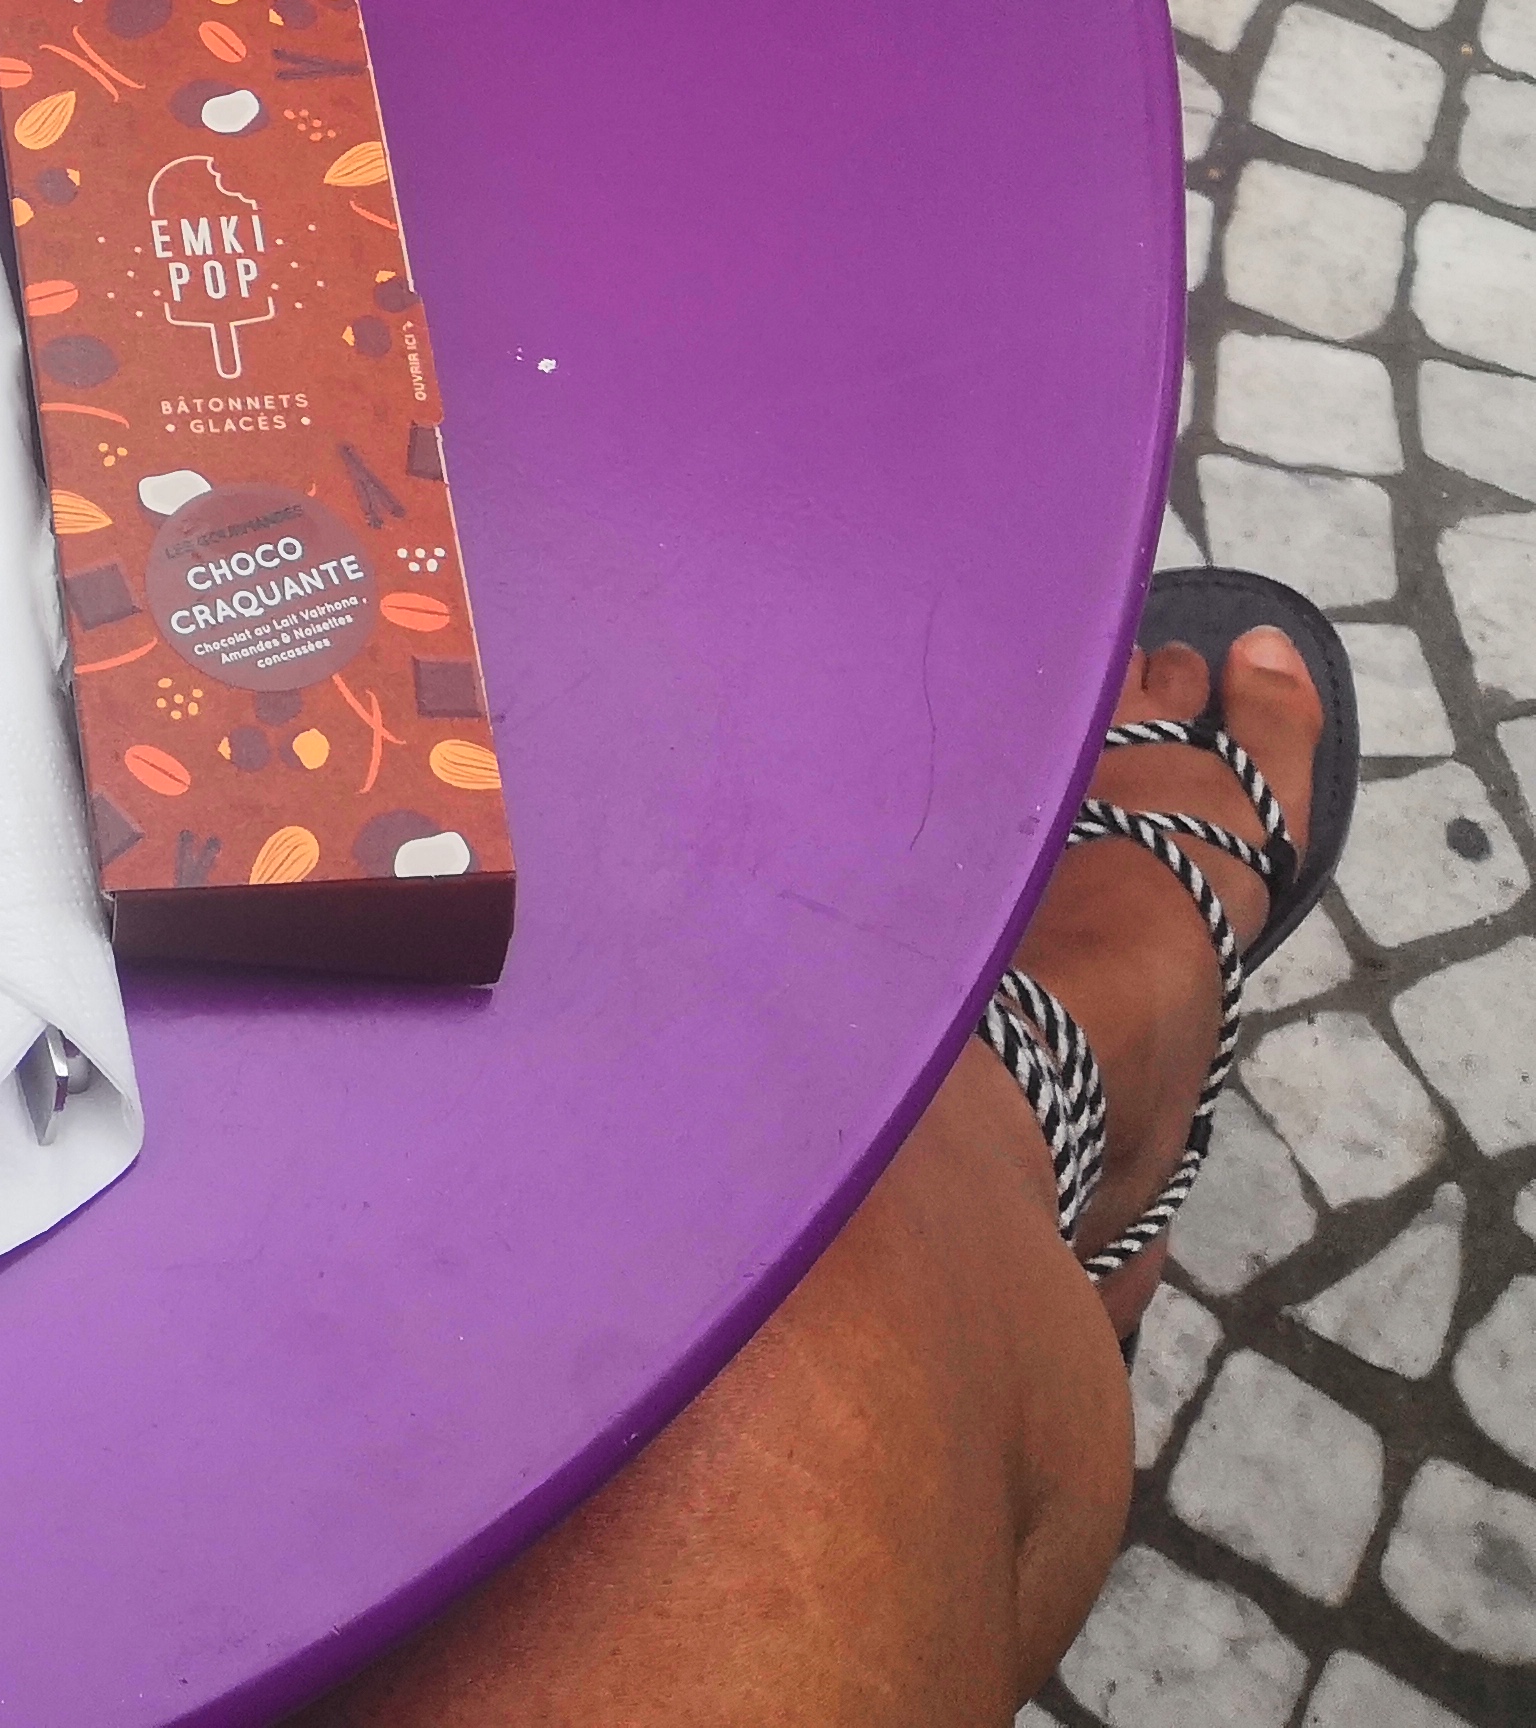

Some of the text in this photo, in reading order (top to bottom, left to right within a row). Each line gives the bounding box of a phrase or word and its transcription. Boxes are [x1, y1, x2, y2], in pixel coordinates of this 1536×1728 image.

[151, 215, 265, 258] EMKI
[168, 258, 259, 302] POP
[404, 333, 428, 402] OUVRIR ICI
[160, 393, 309, 415] BÂTONNETS
[189, 411, 287, 434] GLACÉS
[186, 536, 303, 591] CHOCO
[170, 554, 365, 635] CRAQUANTE
[193, 628, 253, 656] Chocolat
[254, 622, 272, 636] au
[273, 613, 299, 630] Lait
[301, 595, 359, 622] Valrhona
[221, 638, 280, 665] Amandes
[294, 613, 354, 641] Noisettes
